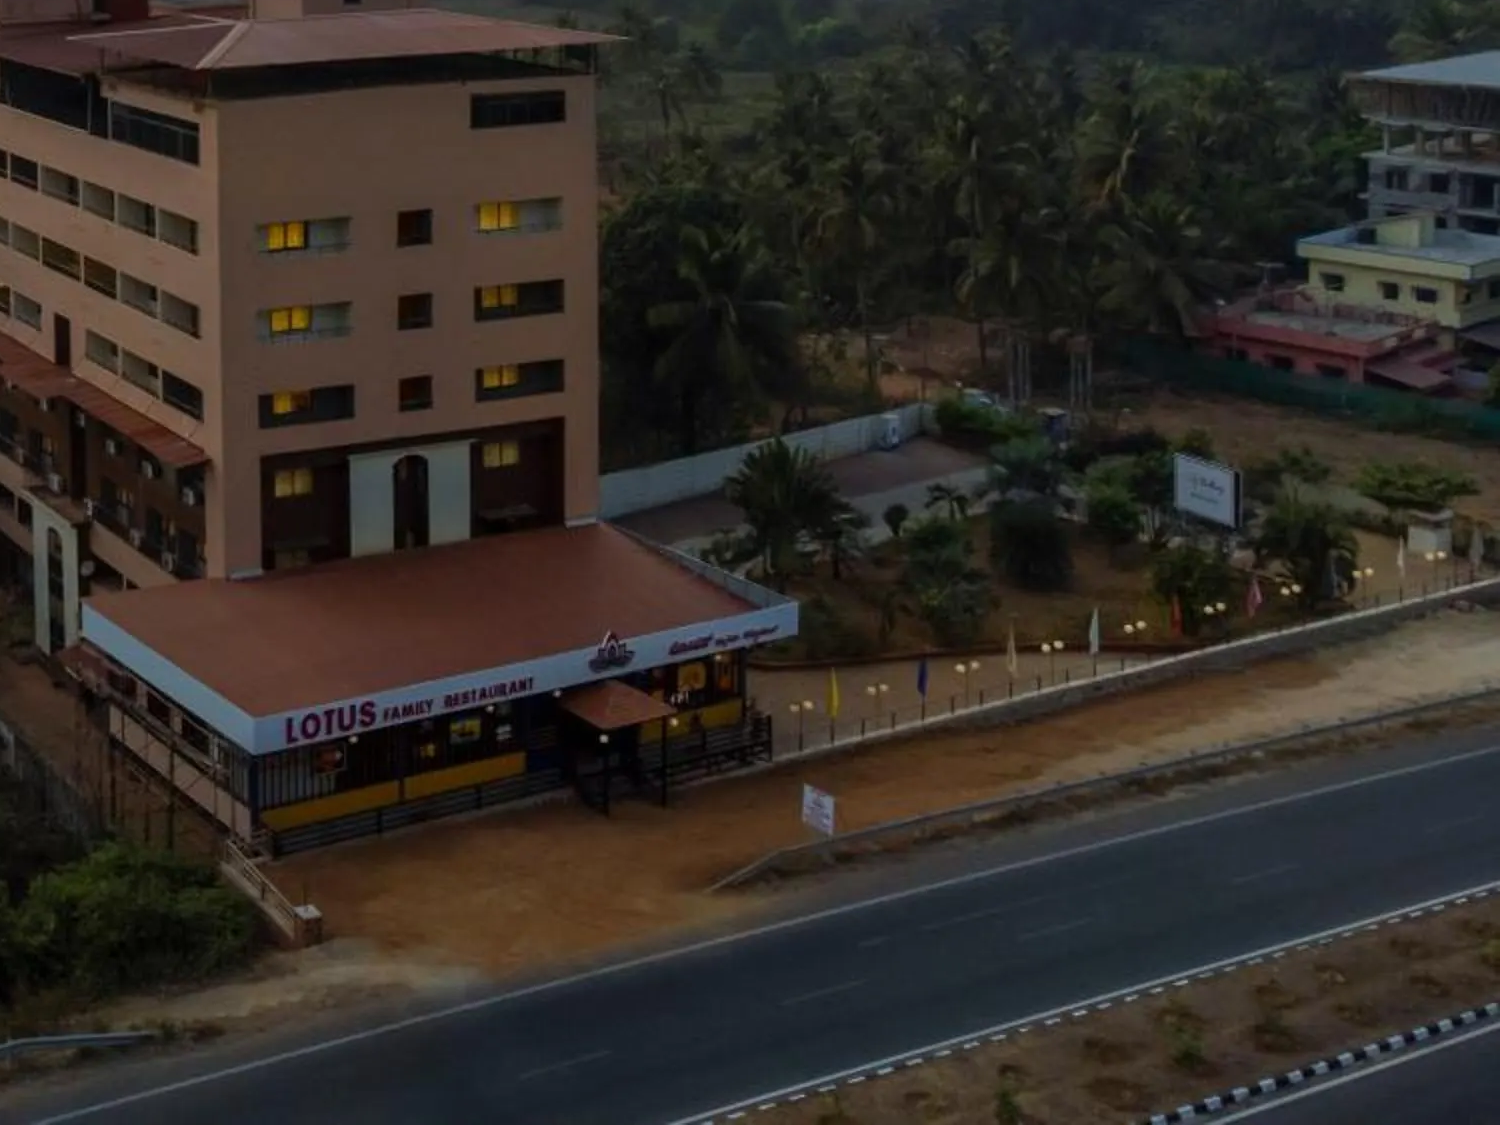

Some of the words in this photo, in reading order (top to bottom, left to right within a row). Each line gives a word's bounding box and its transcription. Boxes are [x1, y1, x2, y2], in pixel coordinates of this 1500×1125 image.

[285, 700, 377, 744] LOTUS
[383, 698, 435, 722] FAMILY
[443, 677, 535, 708] RESTAURANT
